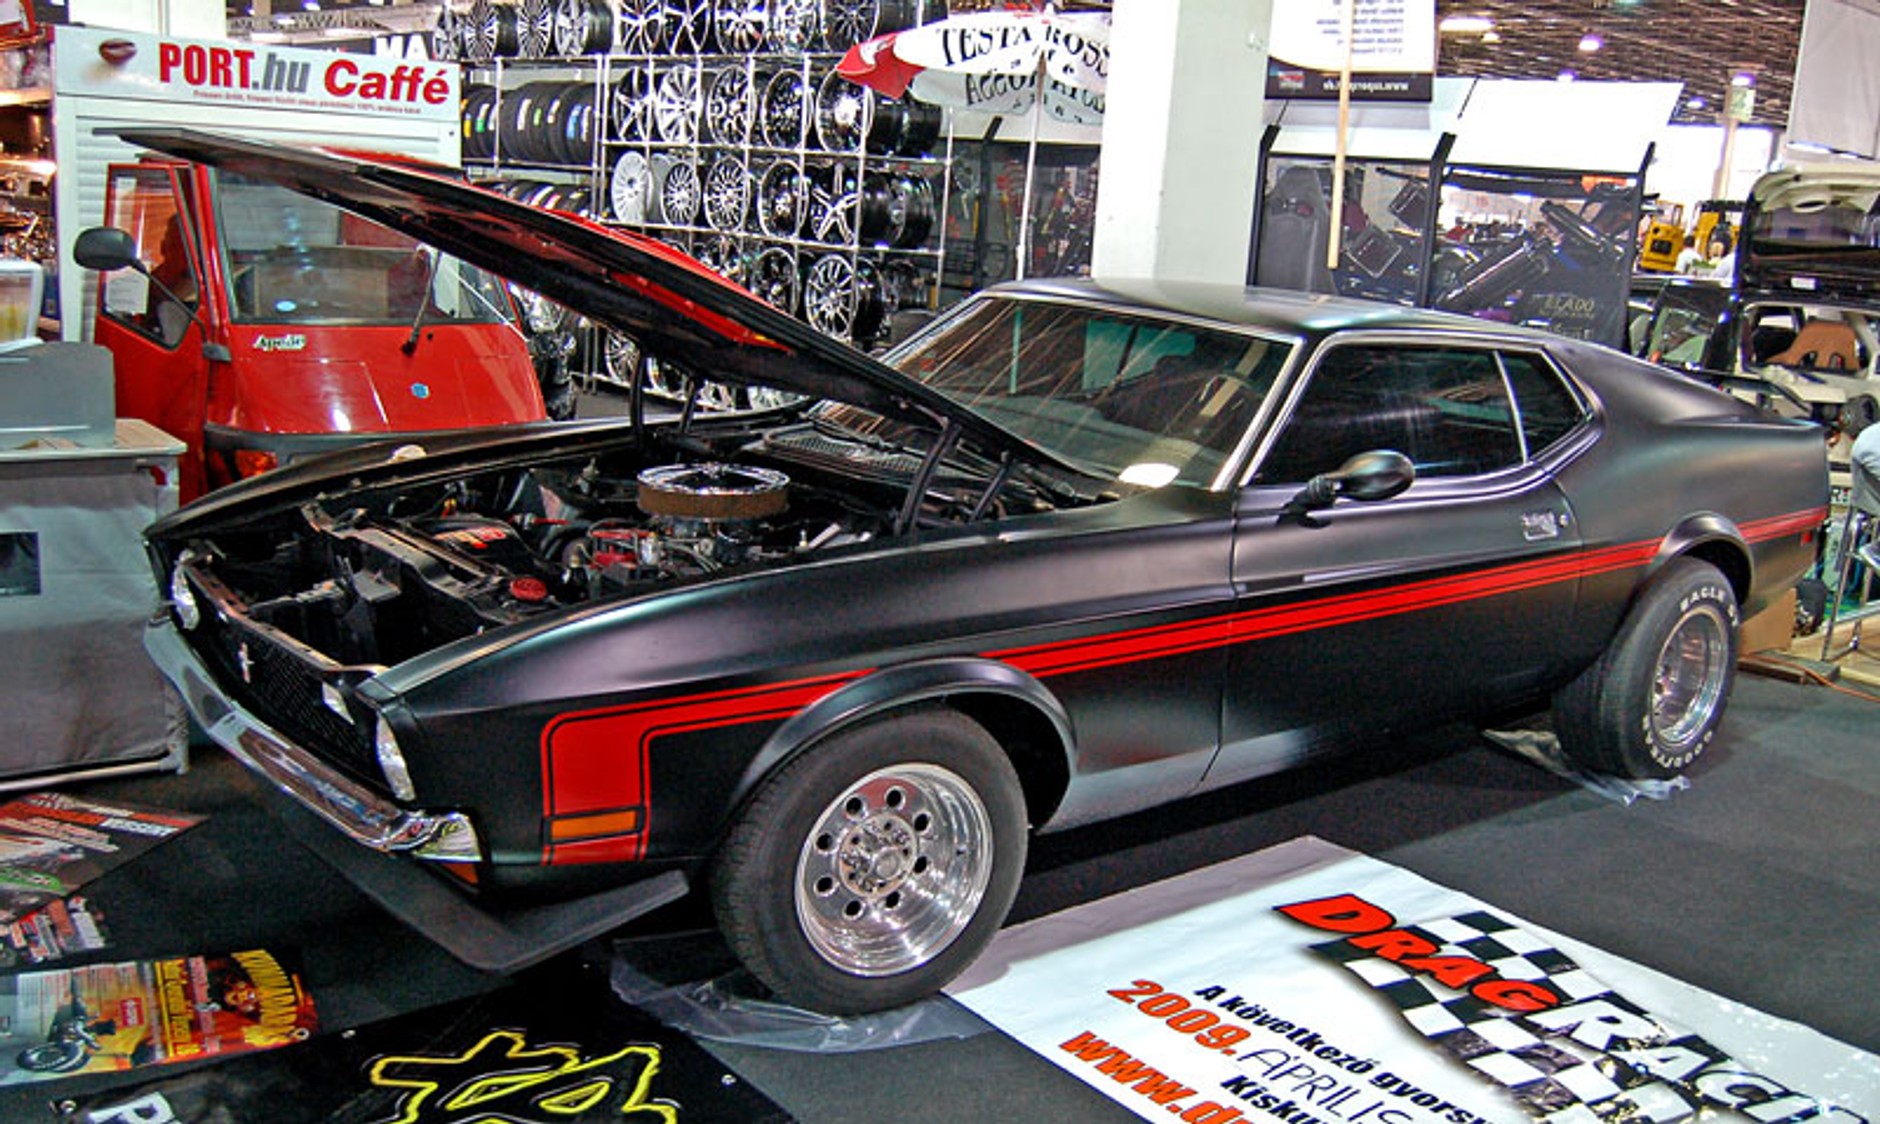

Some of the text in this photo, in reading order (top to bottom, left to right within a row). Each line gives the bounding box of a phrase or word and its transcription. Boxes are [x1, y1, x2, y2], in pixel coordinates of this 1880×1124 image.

[158, 43, 311, 93] PORT.hu
[324, 59, 450, 105] Caffé
[936, 26, 1032, 66] TESTA
[1680, 586, 1726, 612] EAGLE
[1272, 893, 1561, 1013] DRAG
[1106, 978, 1251, 1057] 2009.
[1193, 984, 1227, 1002] A
[1217, 995, 1381, 1075] következő
[1058, 1030, 1254, 1124] www.d
